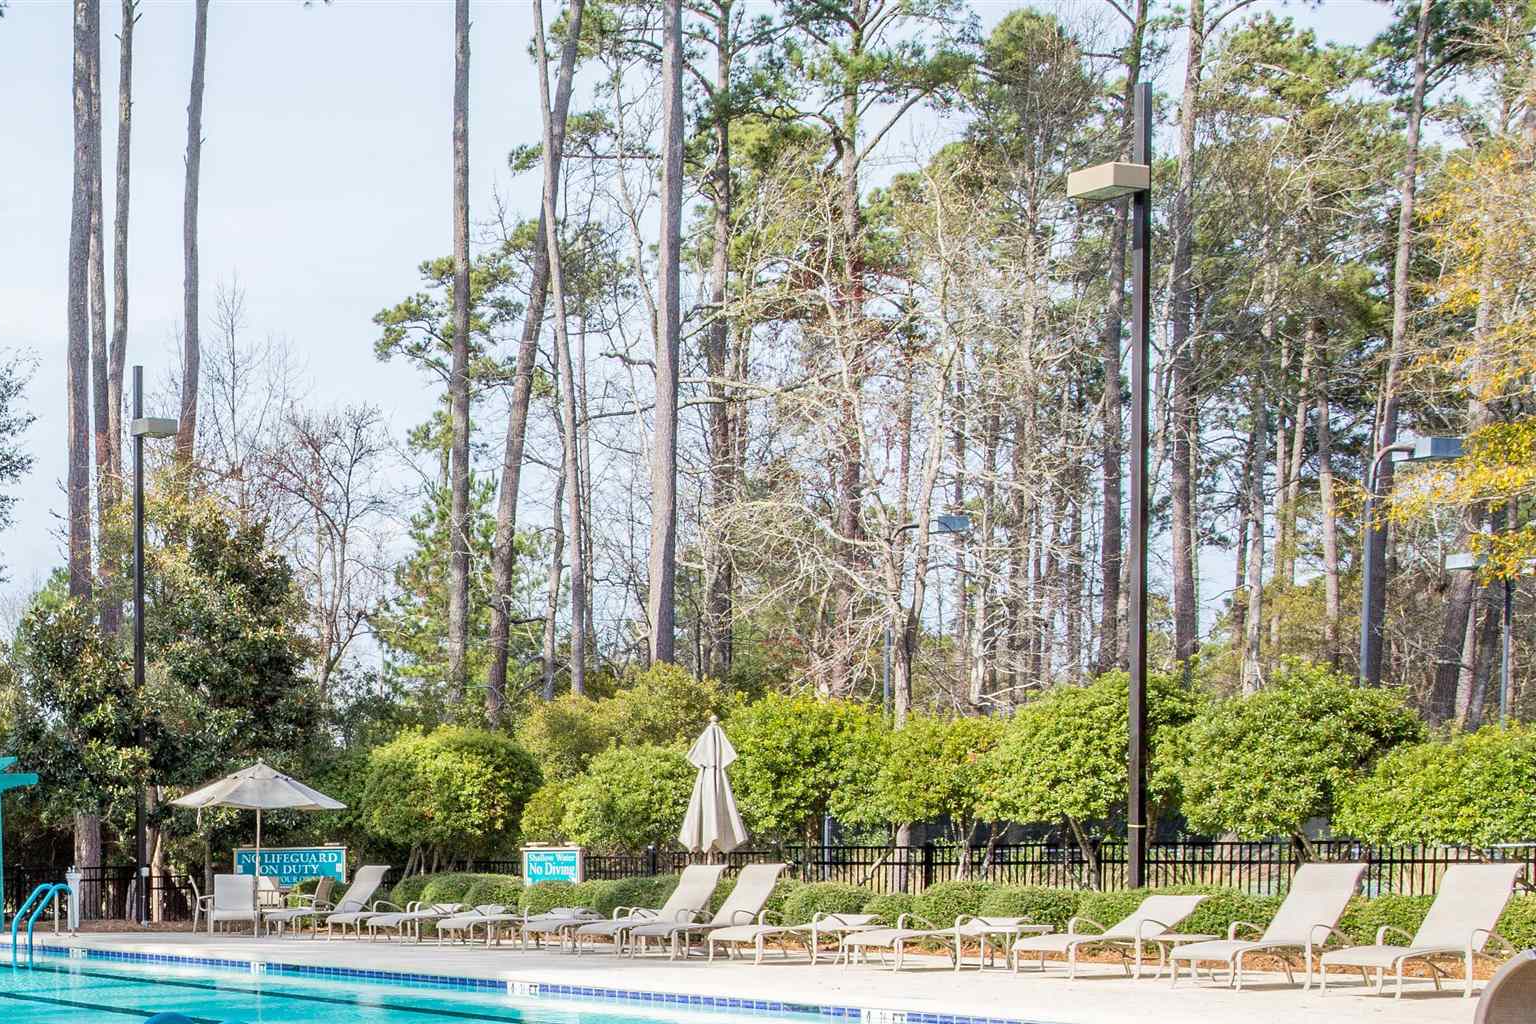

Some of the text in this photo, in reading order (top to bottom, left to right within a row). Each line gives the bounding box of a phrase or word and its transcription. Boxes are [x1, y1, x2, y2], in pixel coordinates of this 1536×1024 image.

[264, 852, 338, 864] LIFEGUARD
[260, 864, 319, 875] ON DUTY
[529, 862, 576, 877] No Diving
